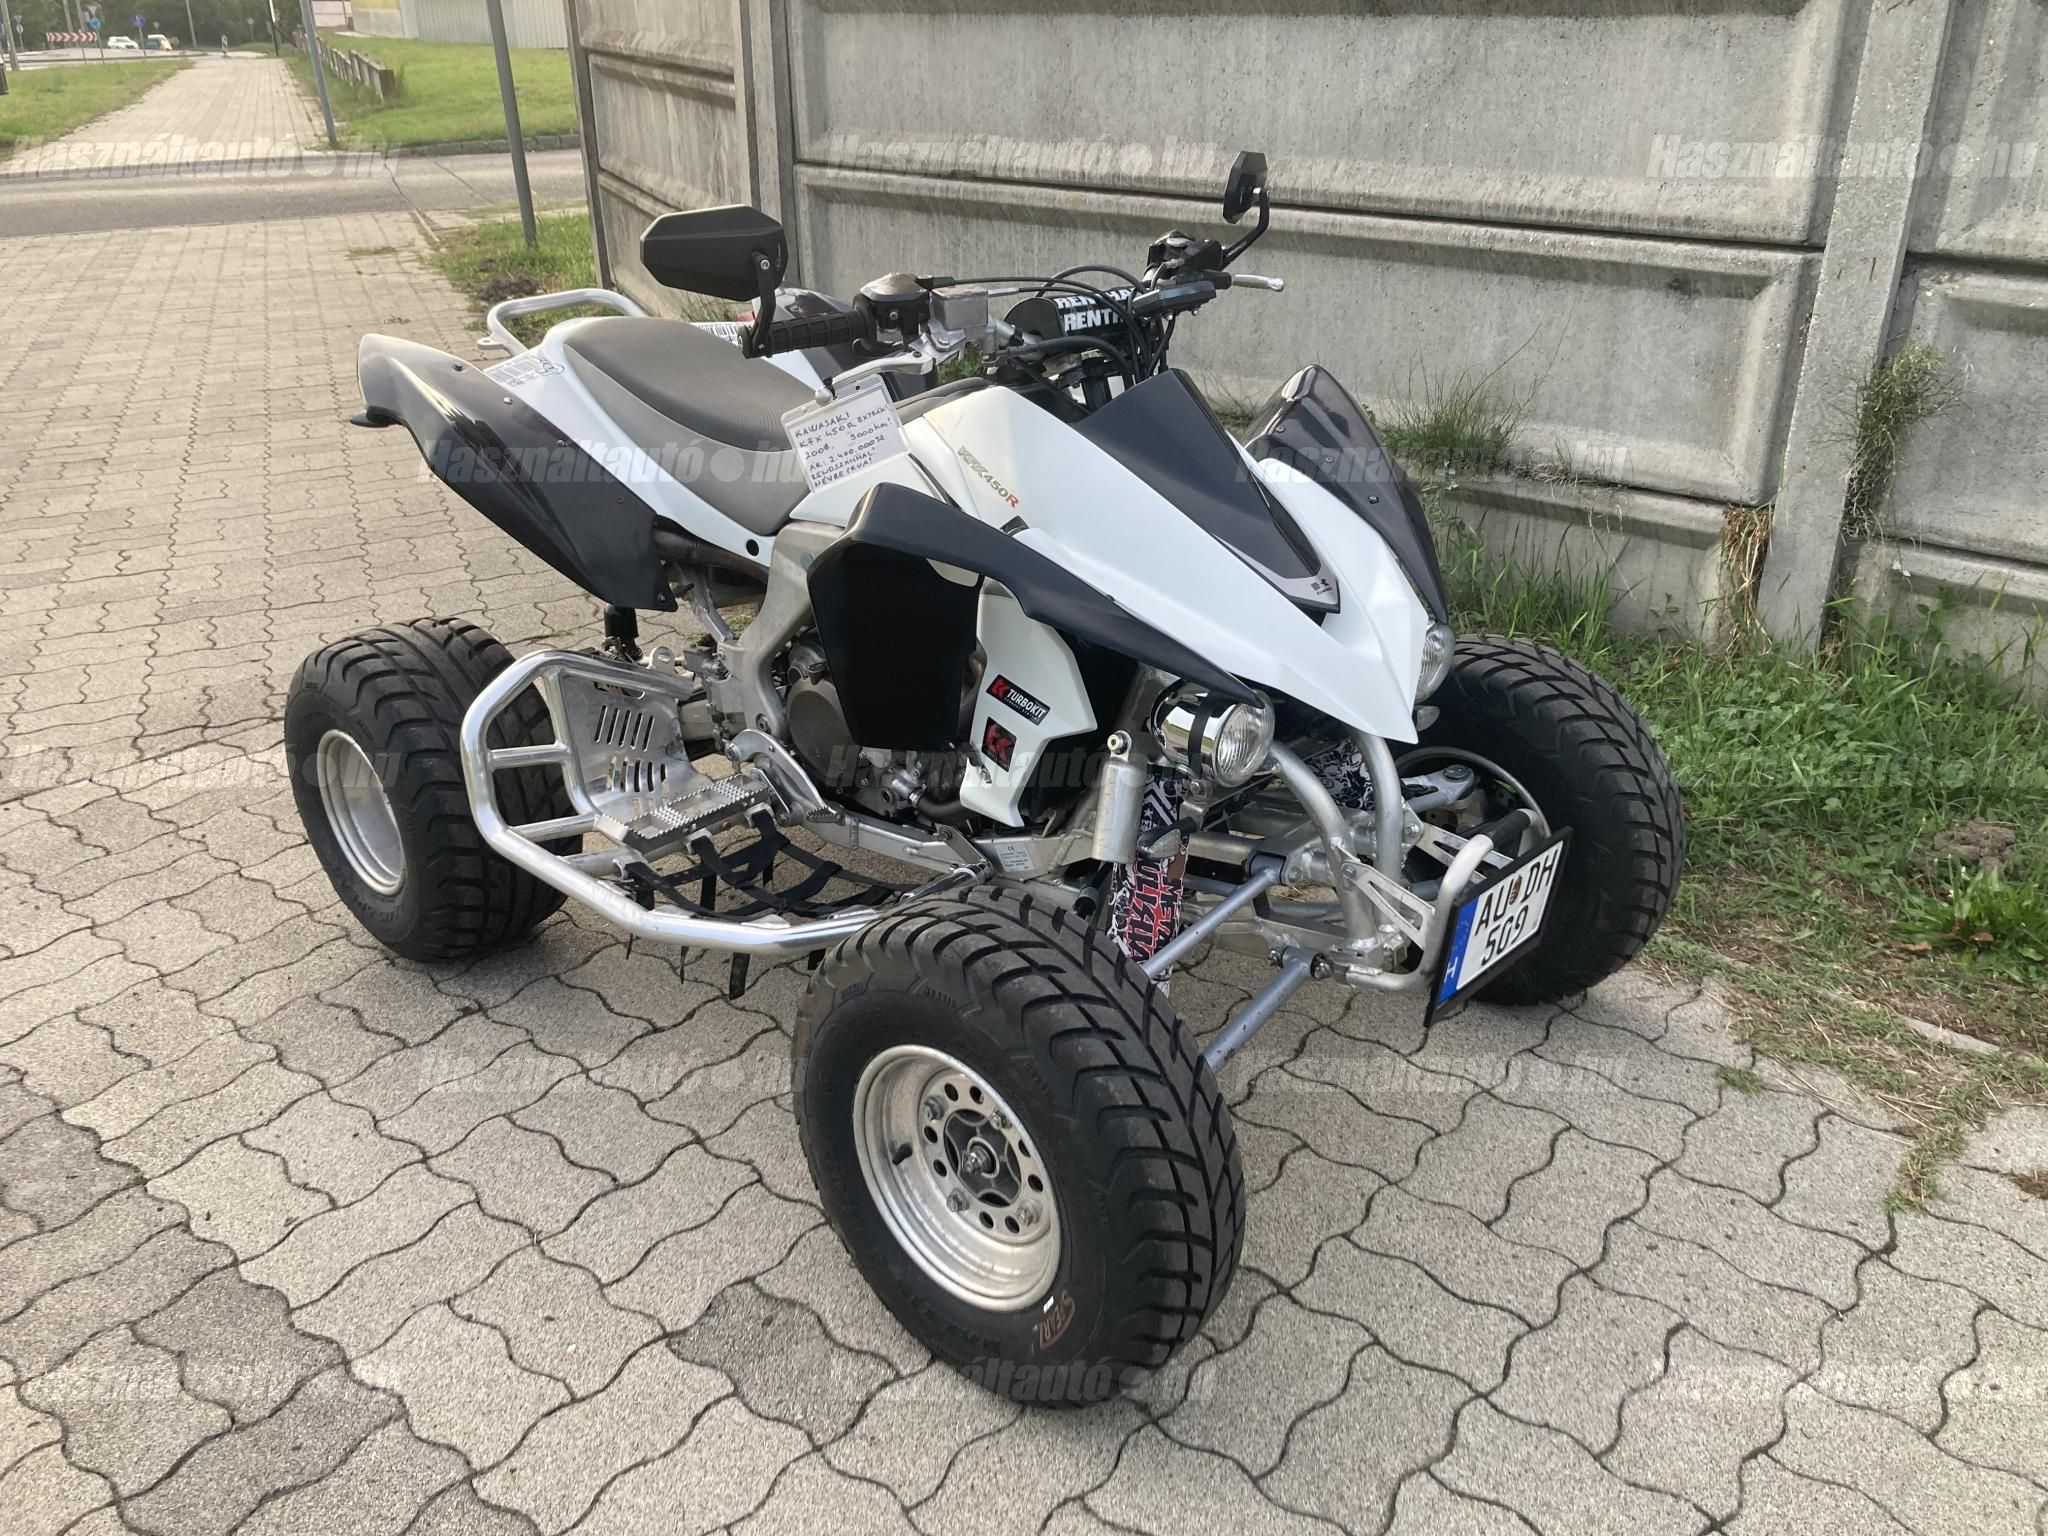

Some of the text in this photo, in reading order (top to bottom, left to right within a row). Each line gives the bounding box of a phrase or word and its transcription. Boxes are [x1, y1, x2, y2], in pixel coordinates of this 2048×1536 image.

[1006, 688, 1046, 718] TURBOKIT
[1475, 848, 1558, 937] AU DH
[1481, 904, 1528, 967] 509
[1444, 957, 1458, 984] H
